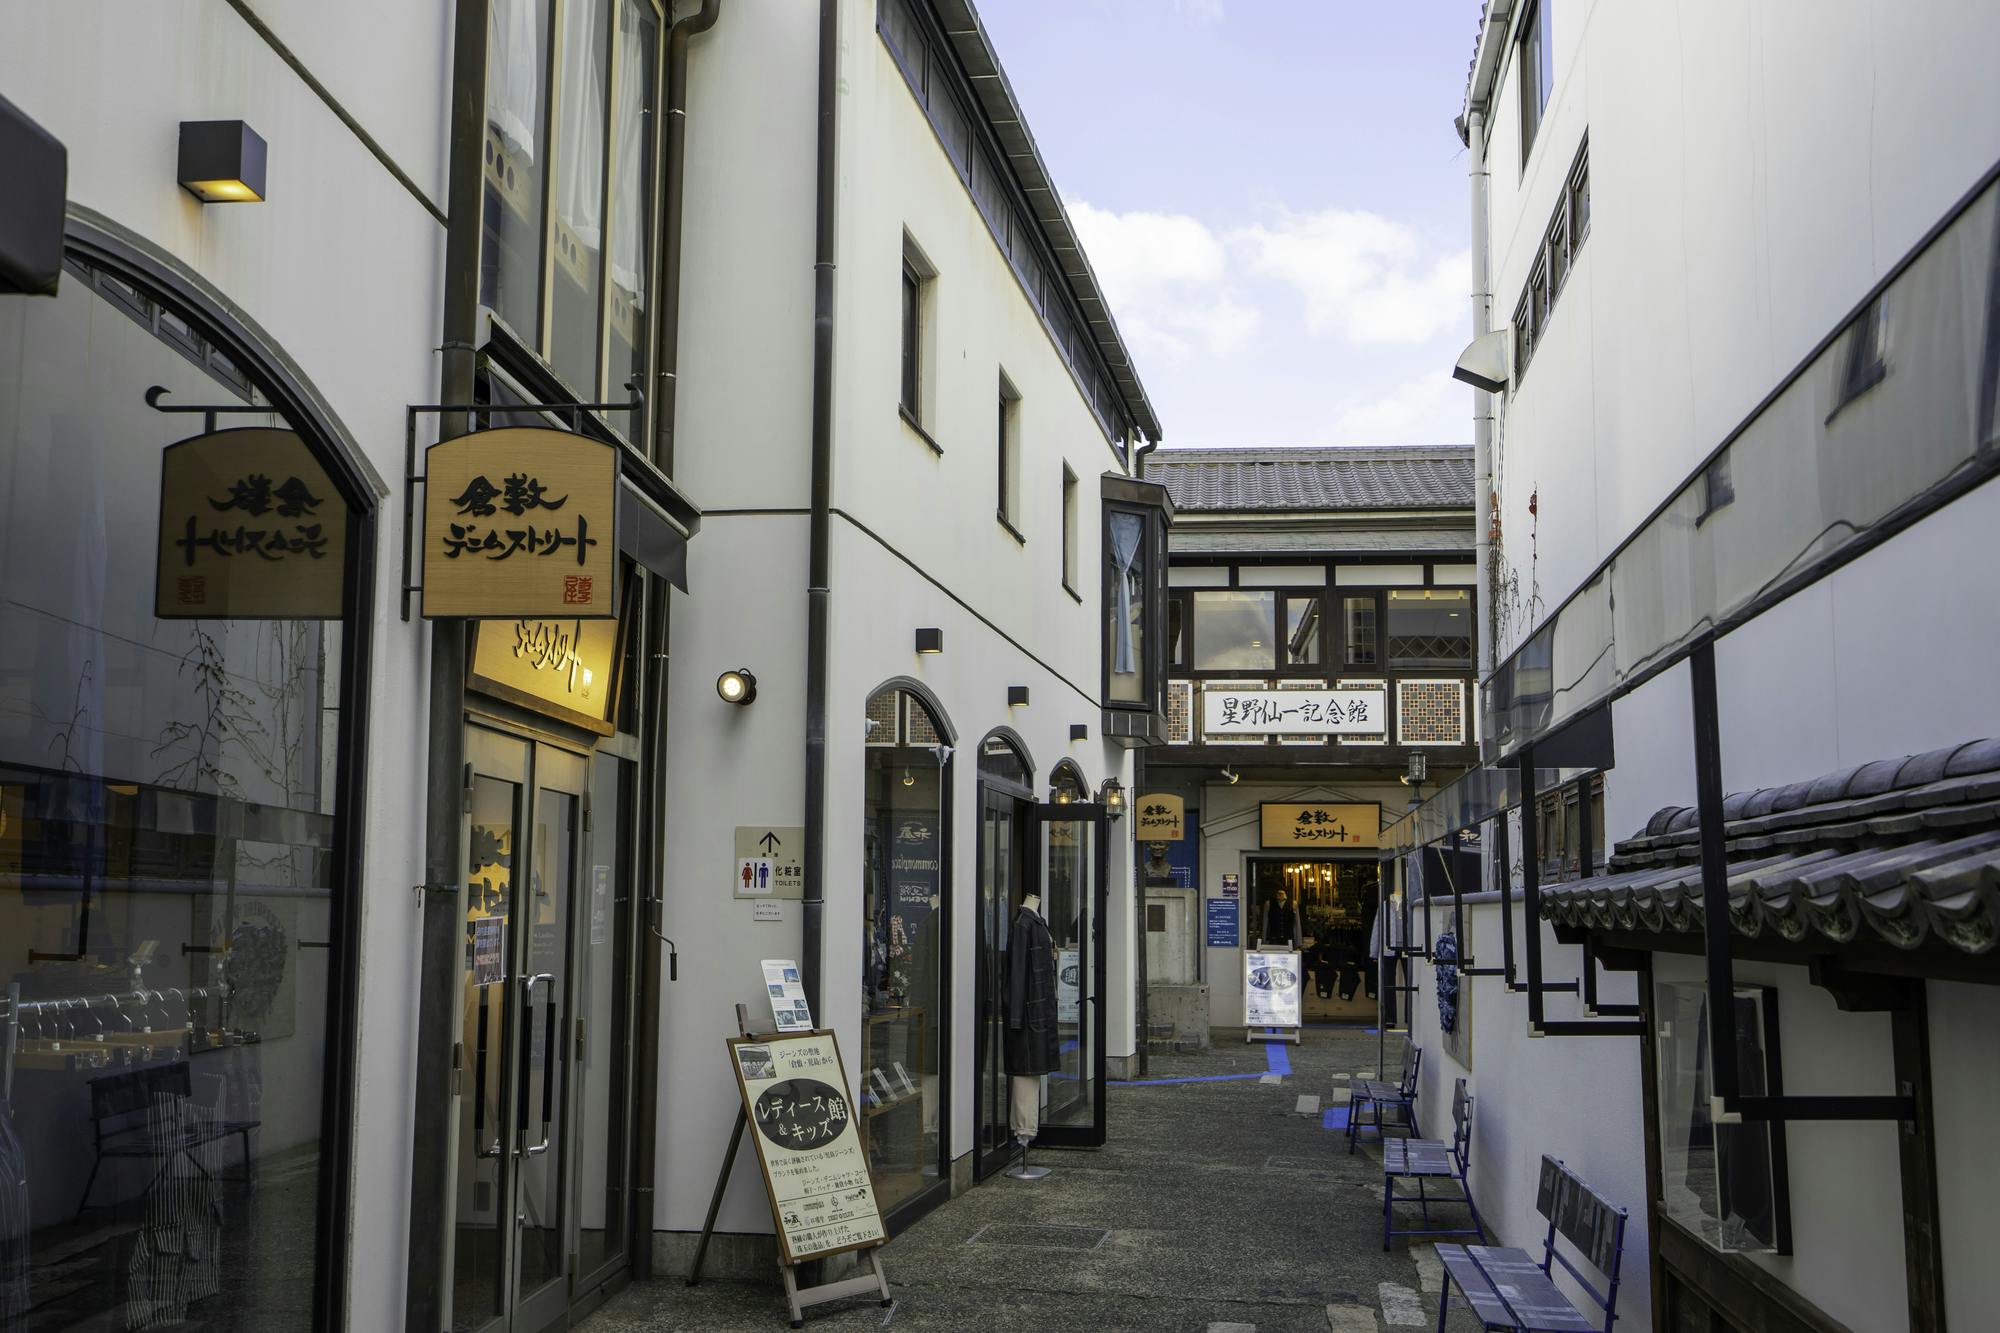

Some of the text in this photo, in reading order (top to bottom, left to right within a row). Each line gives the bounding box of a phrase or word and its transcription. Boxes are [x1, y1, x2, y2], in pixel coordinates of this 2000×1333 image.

[449, 472, 569, 517] 倉敷
[443, 514, 597, 566] デニムストリート
[1220, 697, 1368, 726] 星野仙一記念館
[1143, 804, 1173, 816] 倉敷
[1296, 810, 1338, 825] 倉敷
[1140, 815, 1180, 828] デニムストリート
[1293, 824, 1349, 843] デニムストリート
[775, 866, 802, 877] 化粧室
[791, 1117, 833, 1142] キッズ
